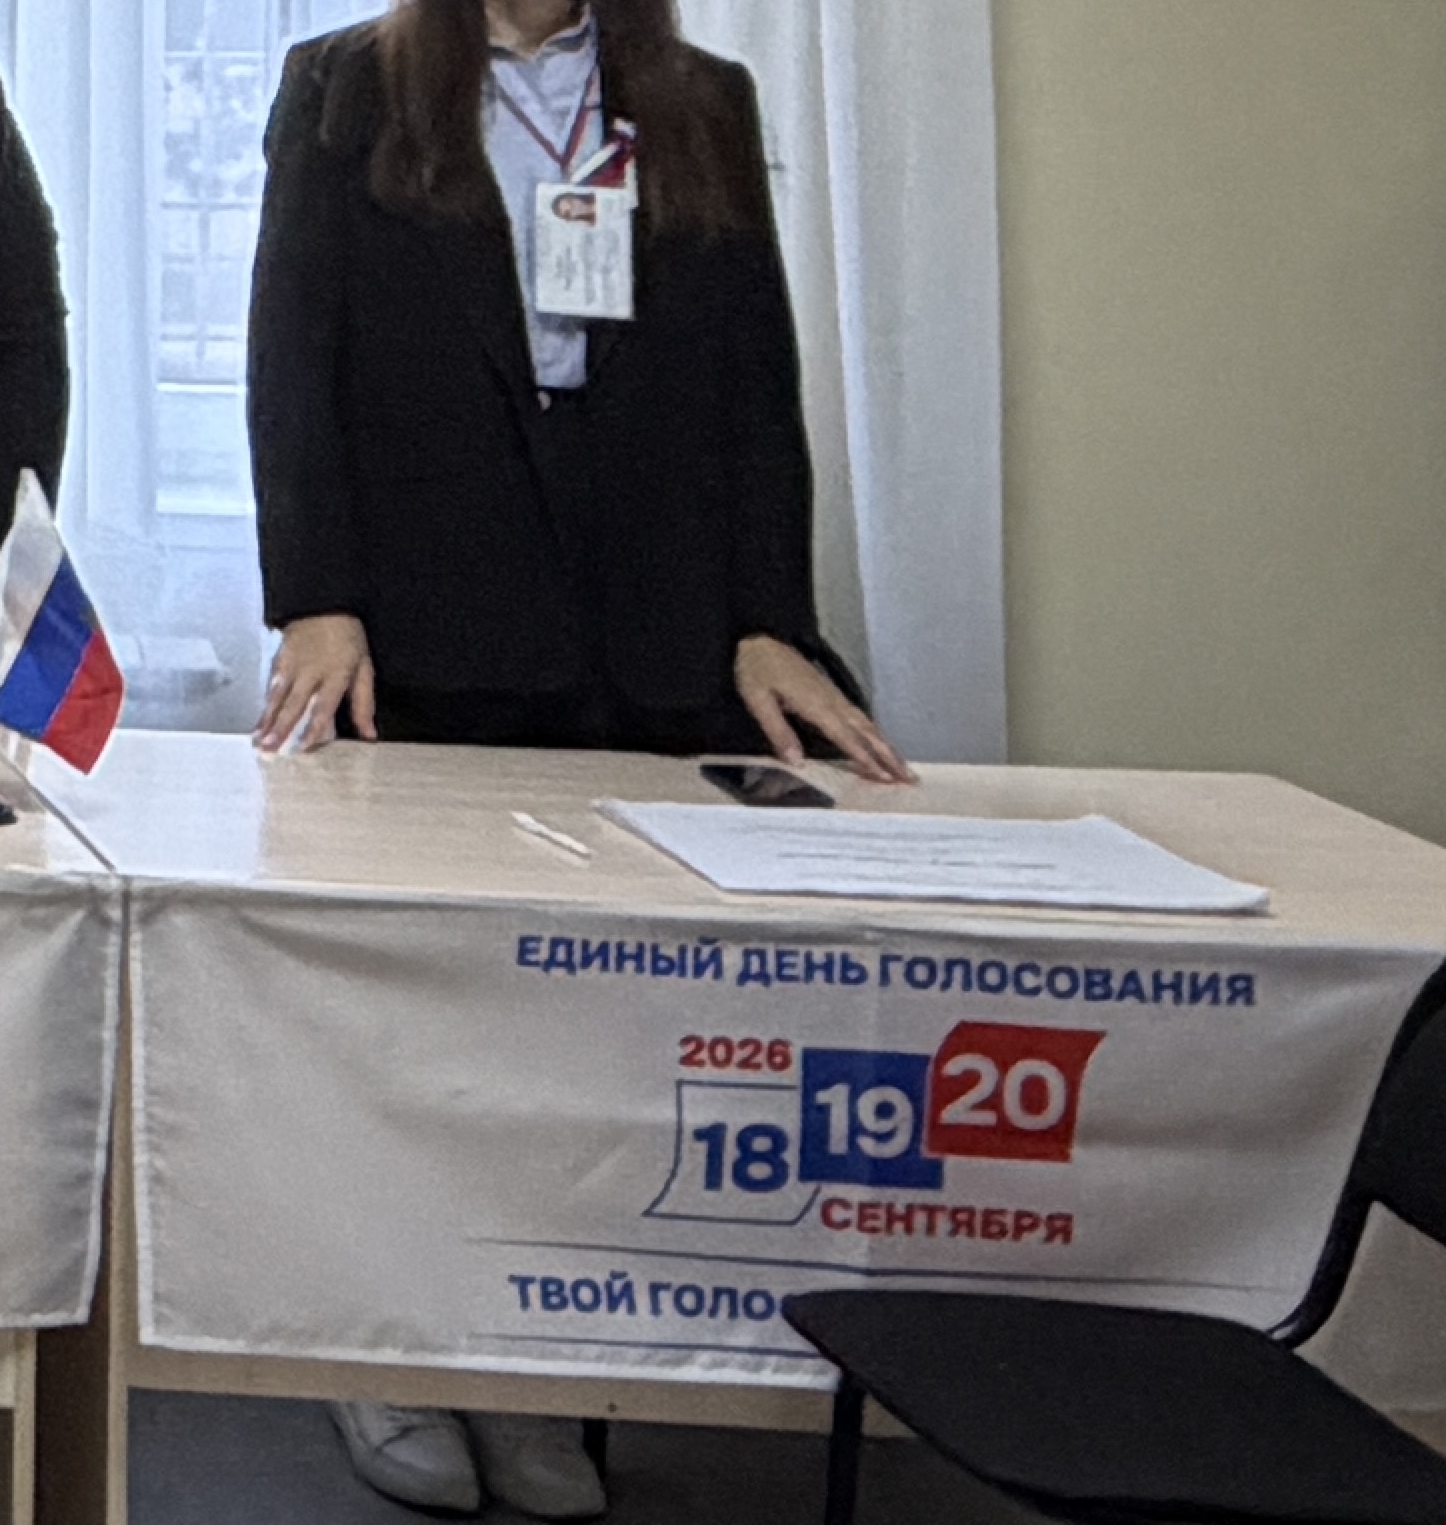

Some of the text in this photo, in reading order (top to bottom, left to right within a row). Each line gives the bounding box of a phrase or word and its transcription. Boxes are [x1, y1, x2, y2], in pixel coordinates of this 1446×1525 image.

[516, 935, 1257, 1006] ЕДИНЫЙ ДЕНЬ ГОЛОСОВАНИЯ
[678, 1034, 792, 1072] 2026
[693, 1046, 1067, 1193] 18 19 20
[820, 1197, 1074, 1245] СЕНТЯБРЯ
[507, 1270, 777, 1321] ТВОЙ ГОЛО
